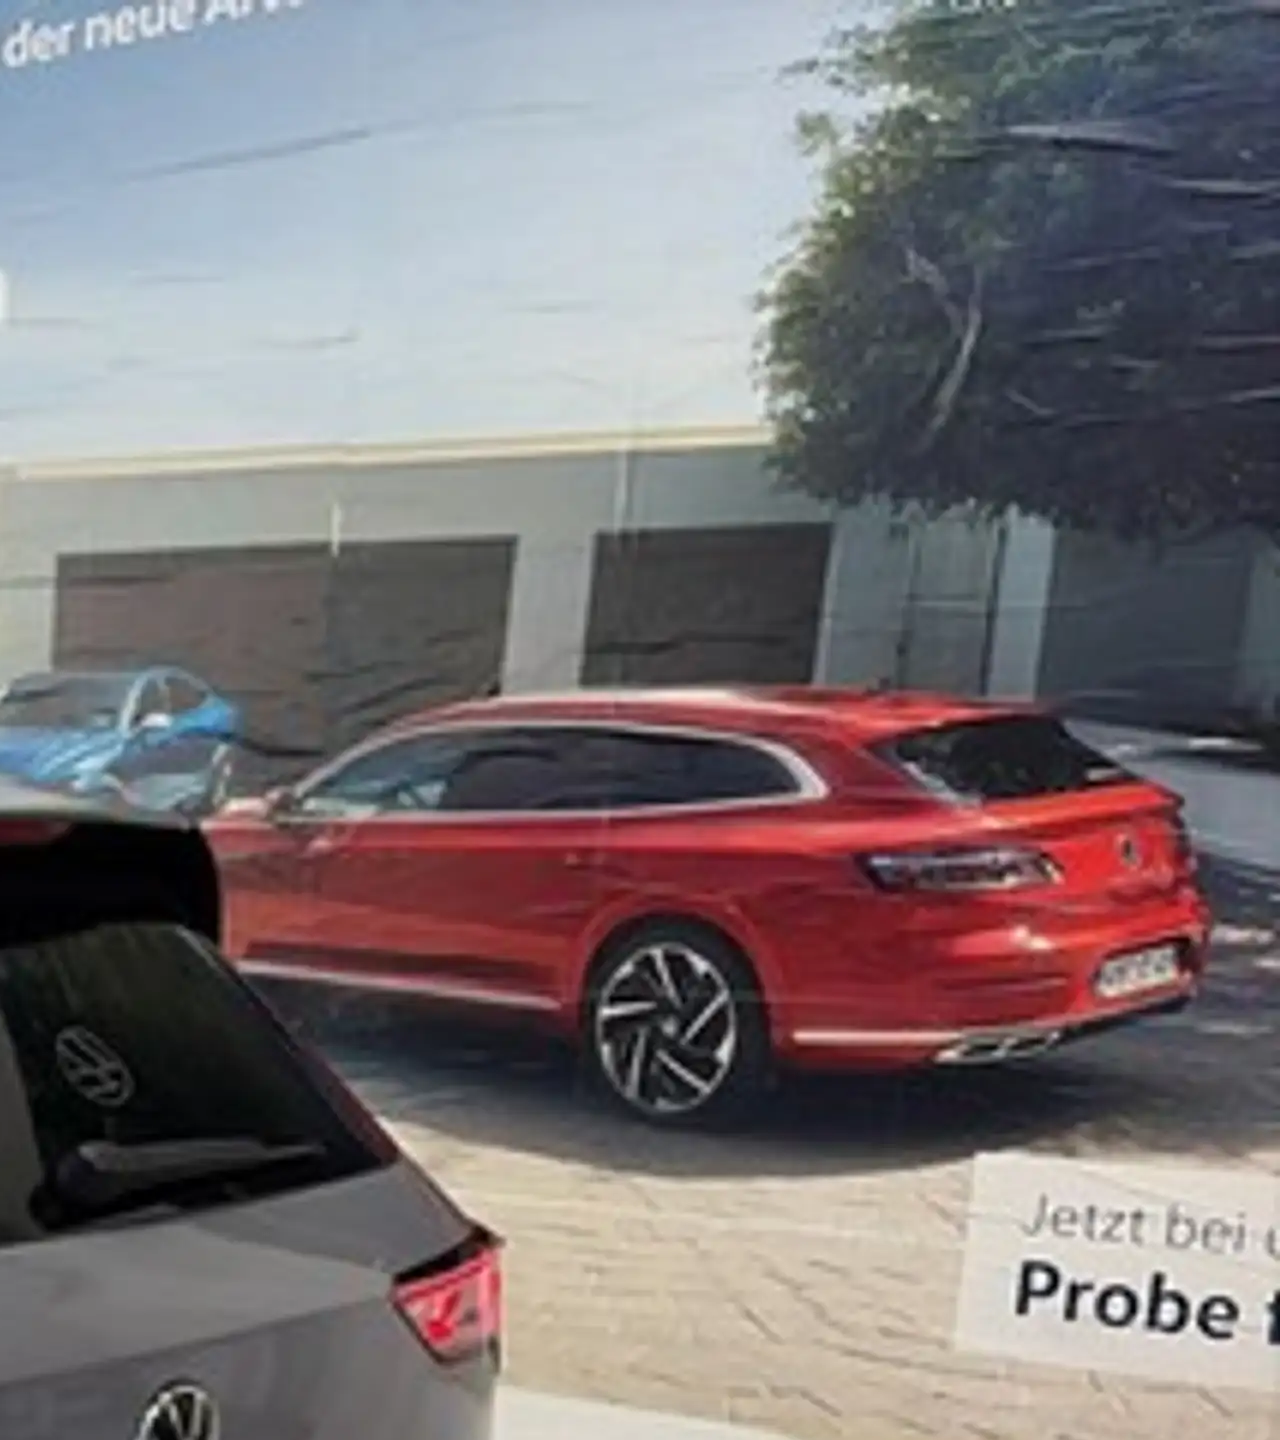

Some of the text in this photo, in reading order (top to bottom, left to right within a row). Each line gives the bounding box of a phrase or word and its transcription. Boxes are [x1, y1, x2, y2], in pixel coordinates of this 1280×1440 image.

[3, 25, 76, 70] der
[85, 0, 194, 51] neue
[1020, 1194, 1146, 1246] Jetzt
[1165, 1205, 1246, 1253] bei
[1015, 1259, 1240, 1340] Probe
